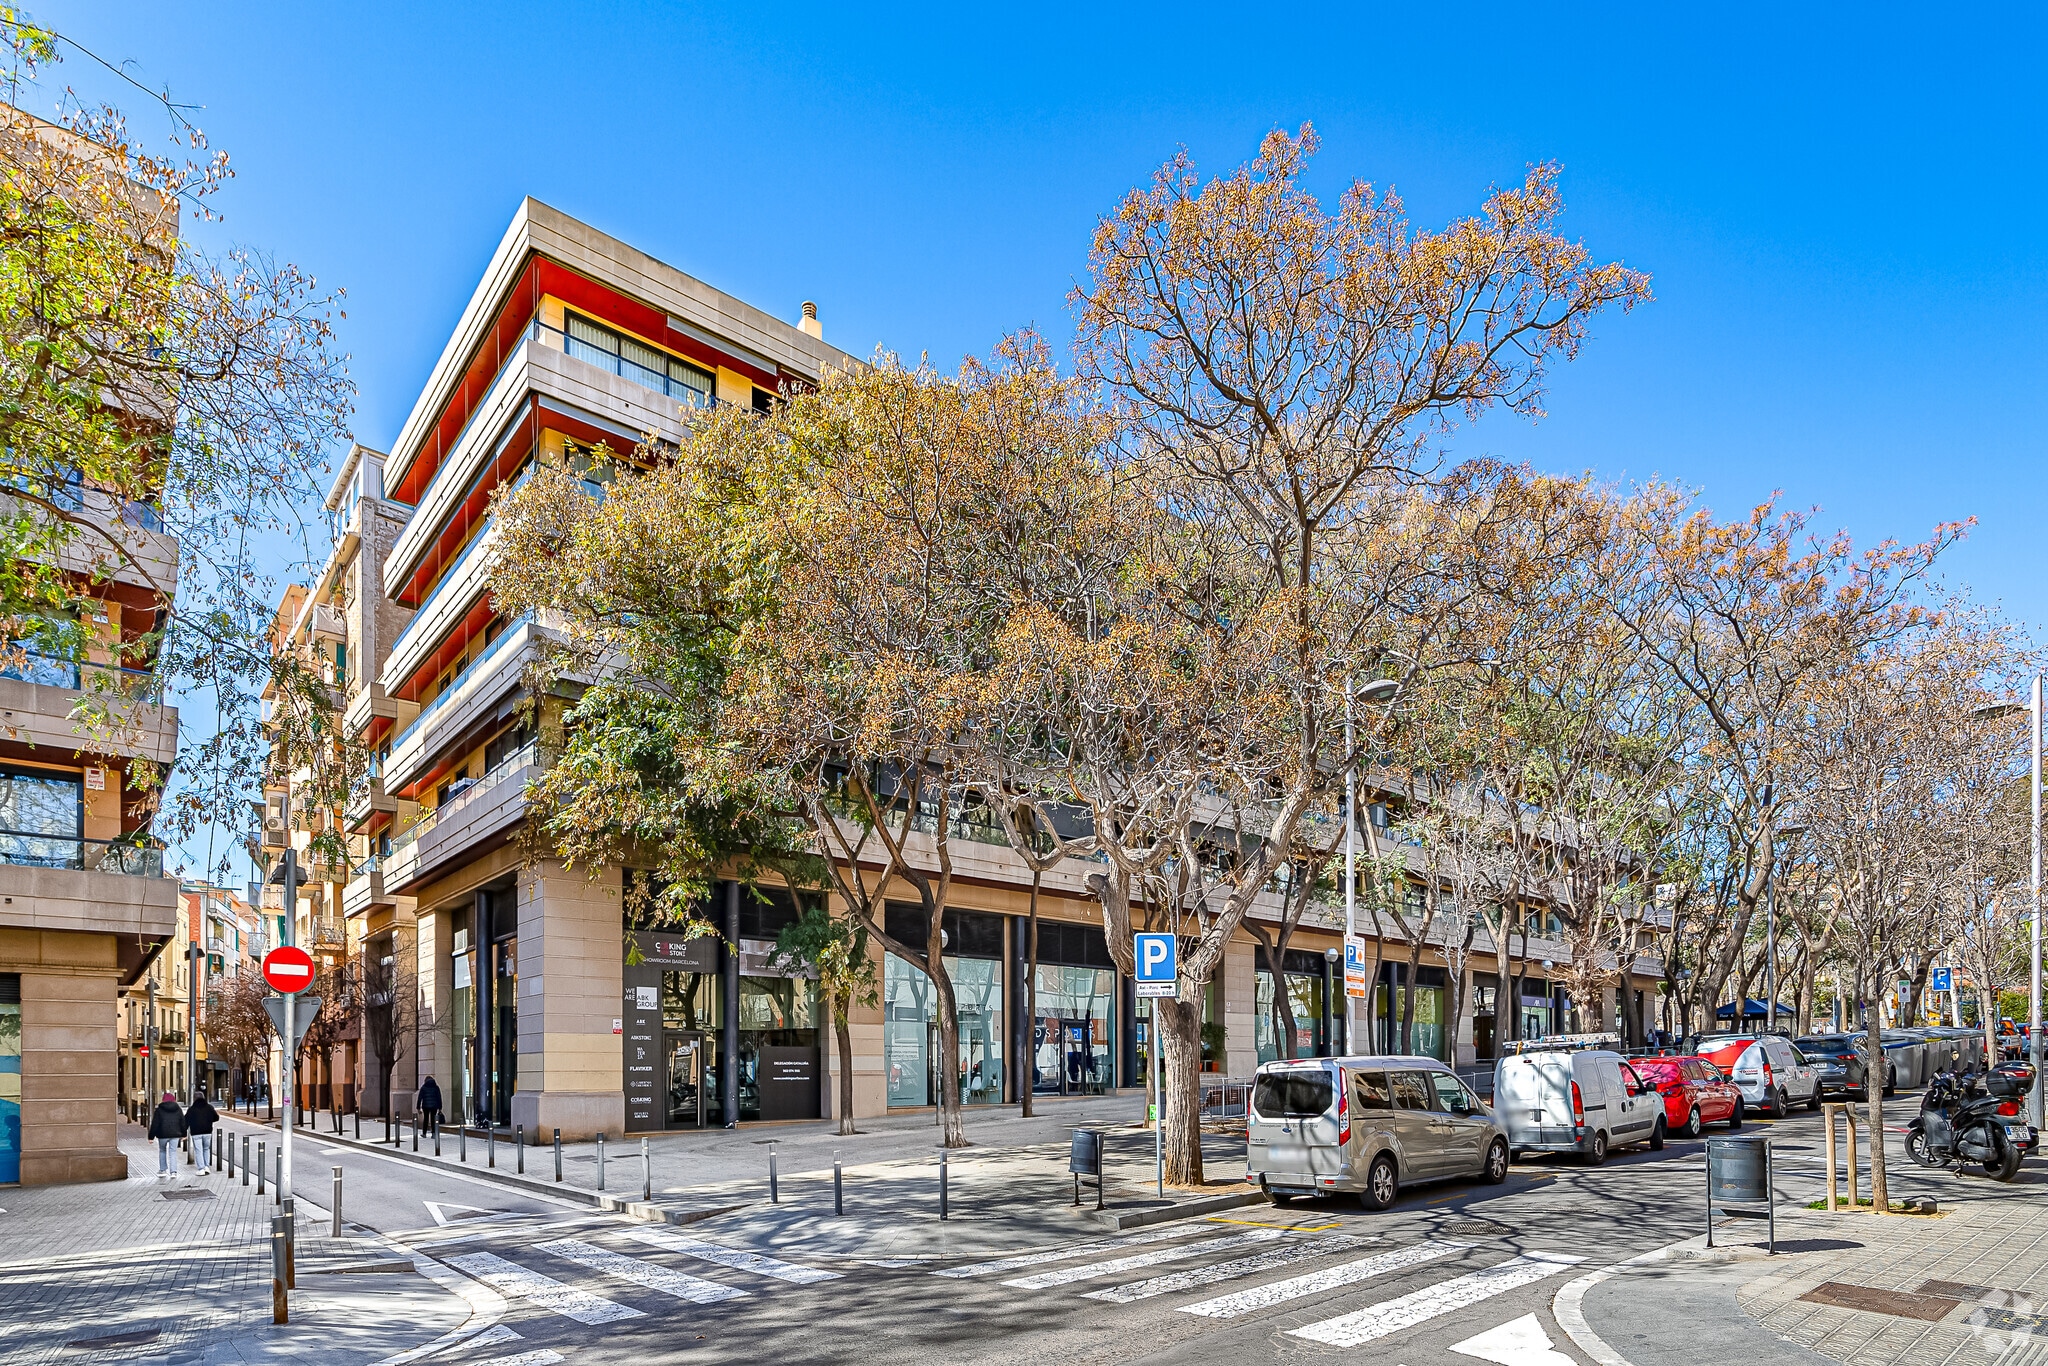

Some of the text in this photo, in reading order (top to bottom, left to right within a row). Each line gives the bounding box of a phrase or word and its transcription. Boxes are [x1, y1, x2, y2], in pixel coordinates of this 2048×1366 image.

[1143, 939, 1168, 976] P
[1348, 946, 1354, 961] P
[671, 958, 700, 966] BARCELONA
[1937, 969, 1948, 980] P
